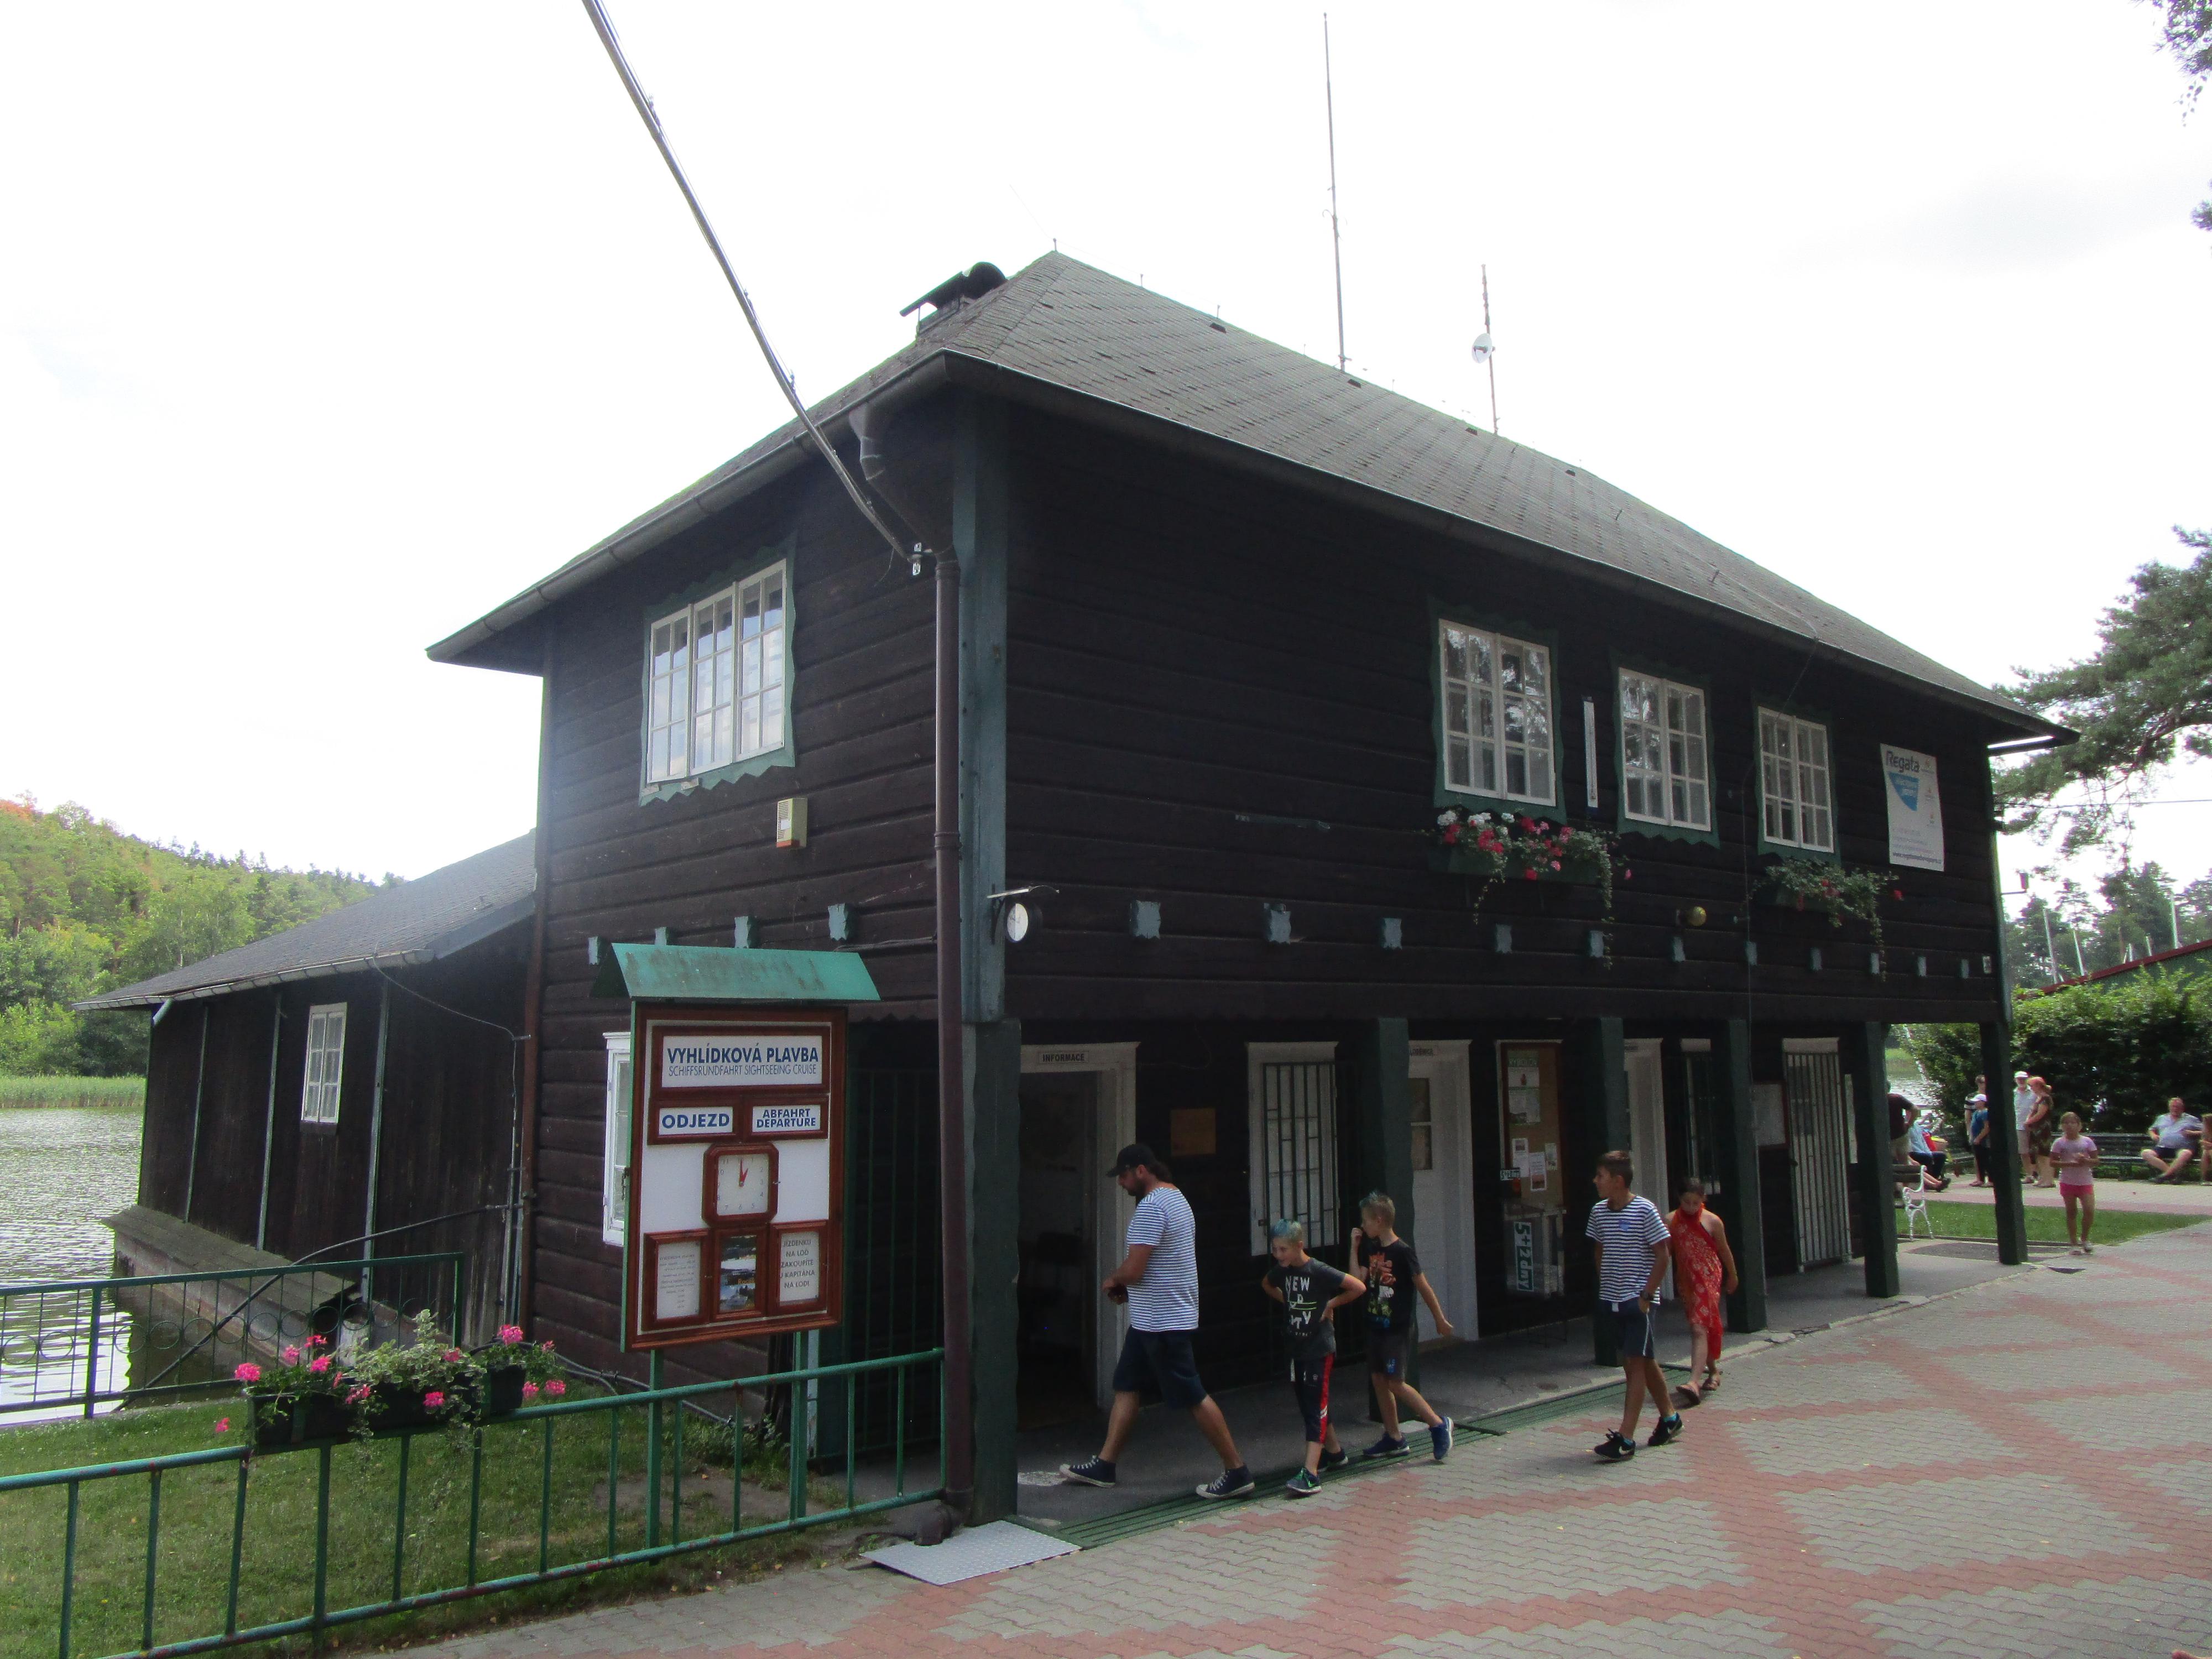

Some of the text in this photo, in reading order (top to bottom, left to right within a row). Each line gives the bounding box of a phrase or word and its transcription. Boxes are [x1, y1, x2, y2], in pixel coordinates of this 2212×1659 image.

[1886, 750, 1919, 773] Regata
[667, 1043, 818, 1063] VYHLÍDKOVÁ PLAVBA
[1043, 1053, 1084, 1062] INFORMACE
[668, 1064, 816, 1076] SCHIFFSRUNDFAHRT SIGHTSEEING CRUISE
[662, 1113, 730, 1129] ODJEZD
[763, 1108, 811, 1118] ABFAHRT
[757, 1118, 816, 1128] DEPARTURE
[1515, 1222, 1533, 1291] 5+2dny
[1285, 1275, 1310, 1292] NEW
